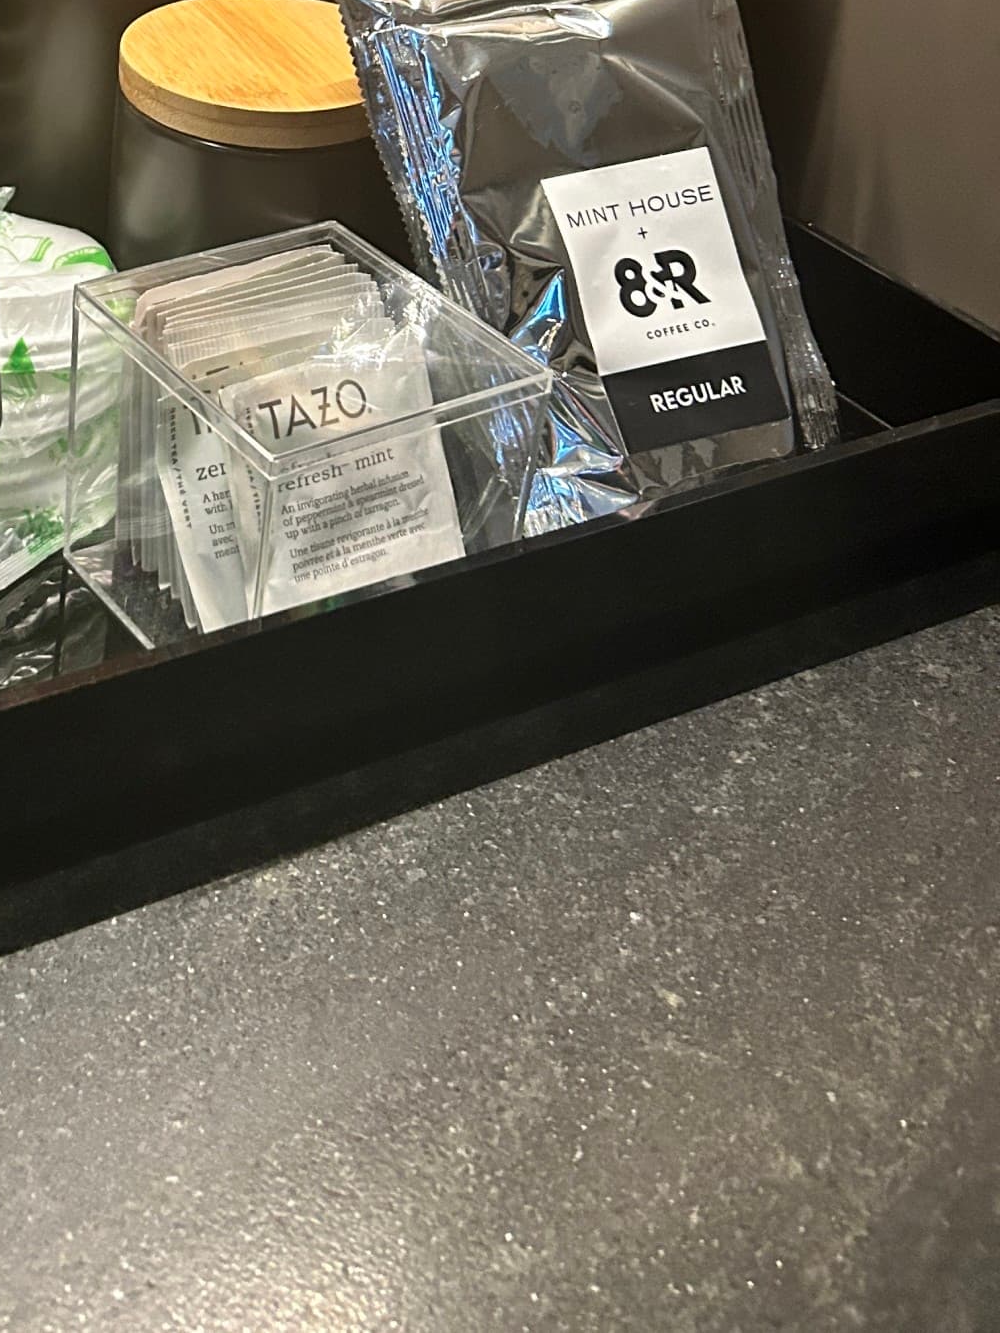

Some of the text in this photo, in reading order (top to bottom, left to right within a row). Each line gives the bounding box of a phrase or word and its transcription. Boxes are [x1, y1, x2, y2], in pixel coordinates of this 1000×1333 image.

[566, 185, 714, 228] MINT HOUSE
[646, 323, 690, 340] COFFEE
[649, 374, 747, 413] REGULAR
[355, 448, 394, 470] mint
[209, 524, 224, 535] Un
[301, 520, 321, 534] with
[290, 546, 308, 558] Une
